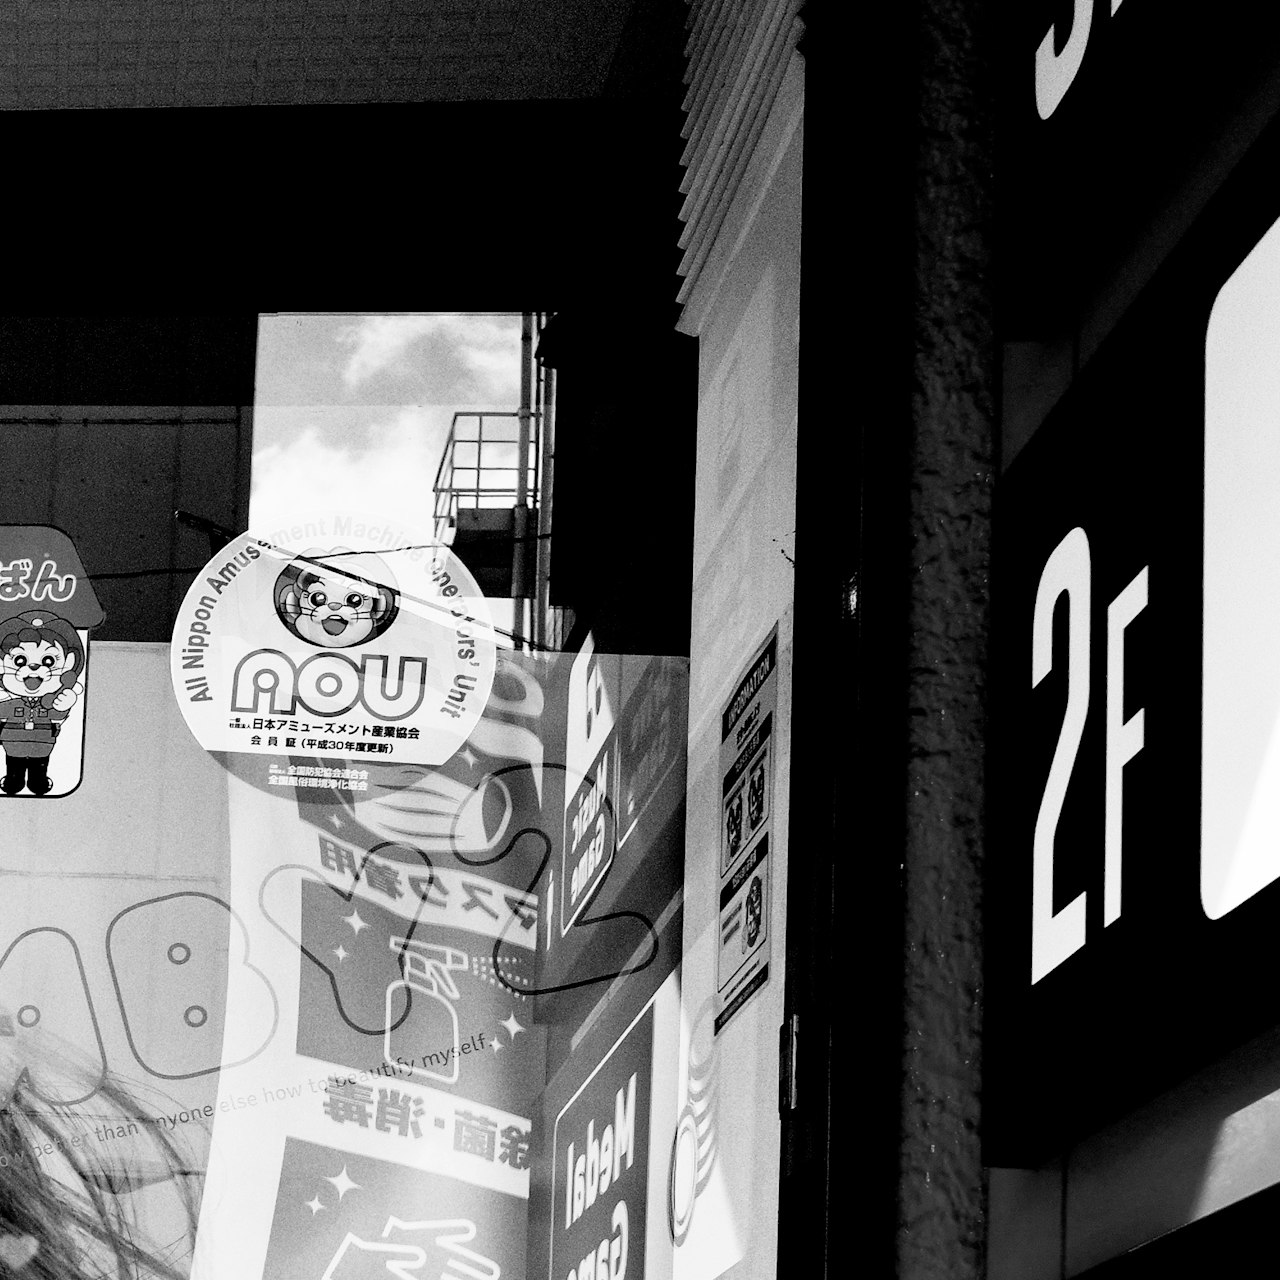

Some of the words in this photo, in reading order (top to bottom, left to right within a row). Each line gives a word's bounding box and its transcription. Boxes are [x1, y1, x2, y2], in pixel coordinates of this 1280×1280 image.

[182, 594, 218, 672] Nippon
[186, 677, 213, 703] All
[231, 648, 428, 721] AOU
[252, 718, 420, 740] 日本アミューズメント産業協会
[1032, 525, 1149, 986] 2F
[95, 1123, 139, 1142] than
